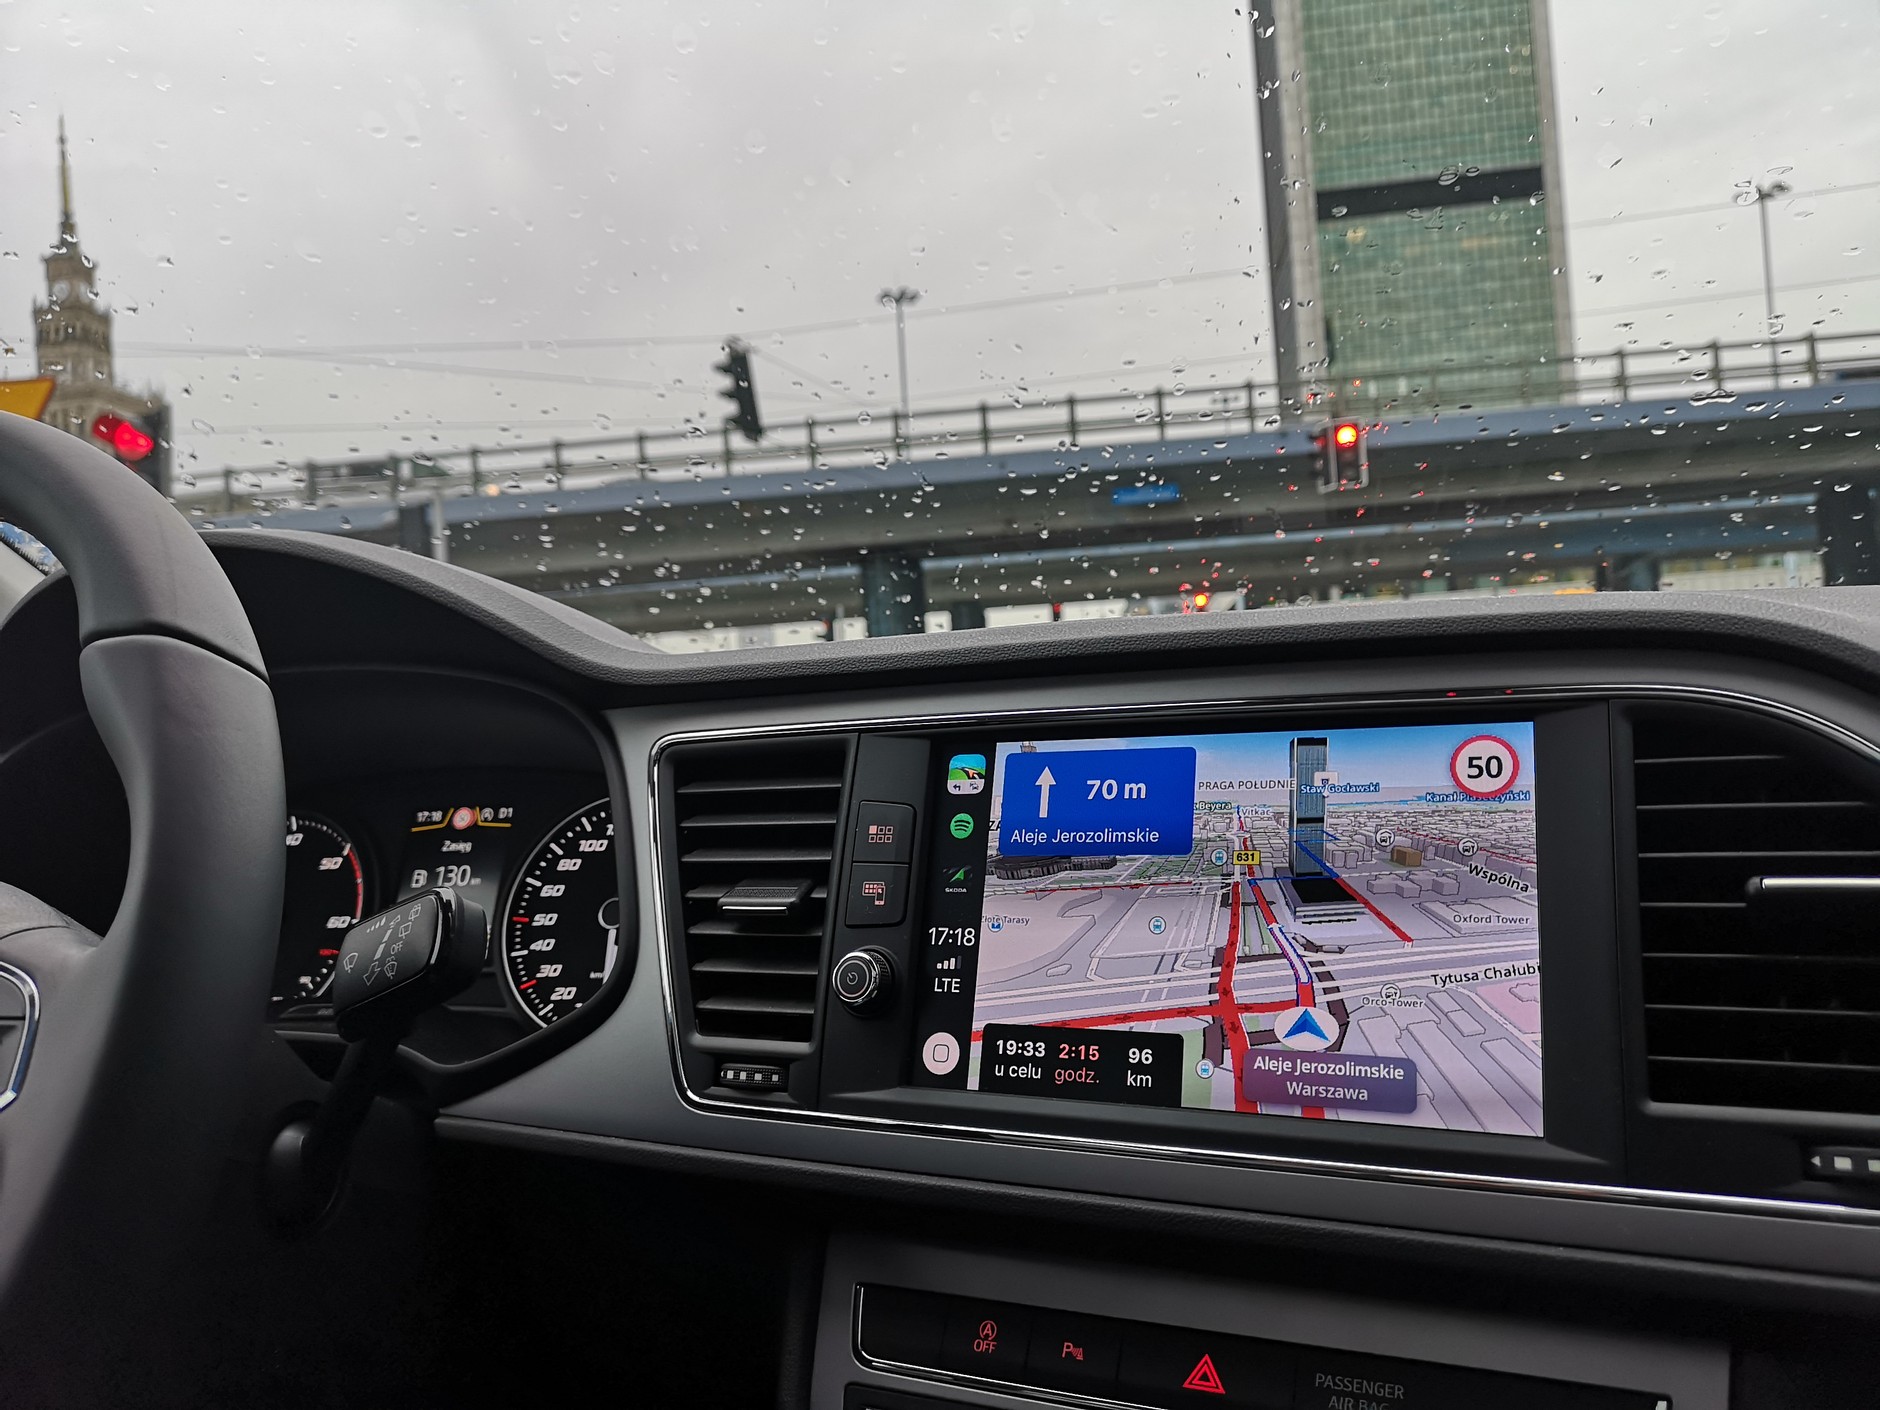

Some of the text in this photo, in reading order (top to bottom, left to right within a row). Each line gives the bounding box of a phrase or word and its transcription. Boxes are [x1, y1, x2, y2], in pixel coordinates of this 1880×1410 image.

[1467, 755, 1503, 779] 50
[1086, 779, 1147, 800] 70 m
[1198, 780, 1296, 790] PRAGA POŁUDNIE
[1301, 785, 1325, 793] Staw
[1199, 802, 1232, 812] Beyera
[1242, 807, 1271, 816] Vitkac
[1010, 828, 1160, 846] Aleje Jerozolimskie
[578, 839, 608, 852] 100
[1236, 852, 1256, 862] 631
[556, 858, 582, 871] 80
[435, 865, 471, 887] 130
[1468, 863, 1530, 893] Wspólna
[539, 884, 565, 897] 60
[326, 916, 351, 929] 60
[531, 913, 558, 926] 50
[1003, 916, 1030, 926] Tarasy
[1453, 914, 1530, 925] Oxford Tower
[928, 927, 976, 947] 17:18
[529, 938, 556, 951] 40
[535, 964, 563, 978] 30
[934, 978, 961, 993] LTE
[1431, 972, 1479, 988] Tytusa
[550, 987, 577, 1000] 20
[995, 1040, 1153, 1064] 19:33 2:15 96
[995, 1062, 1152, 1088] u celu godz. km
[1253, 1056, 1405, 1080] Aleje Jerozolimskie
[1286, 1082, 1369, 1101] Warszawa
[973, 1339, 997, 1354] OFF
[1315, 1373, 1405, 1400] PASSENGER
[1328, 1395, 1354, 1410] AIR
